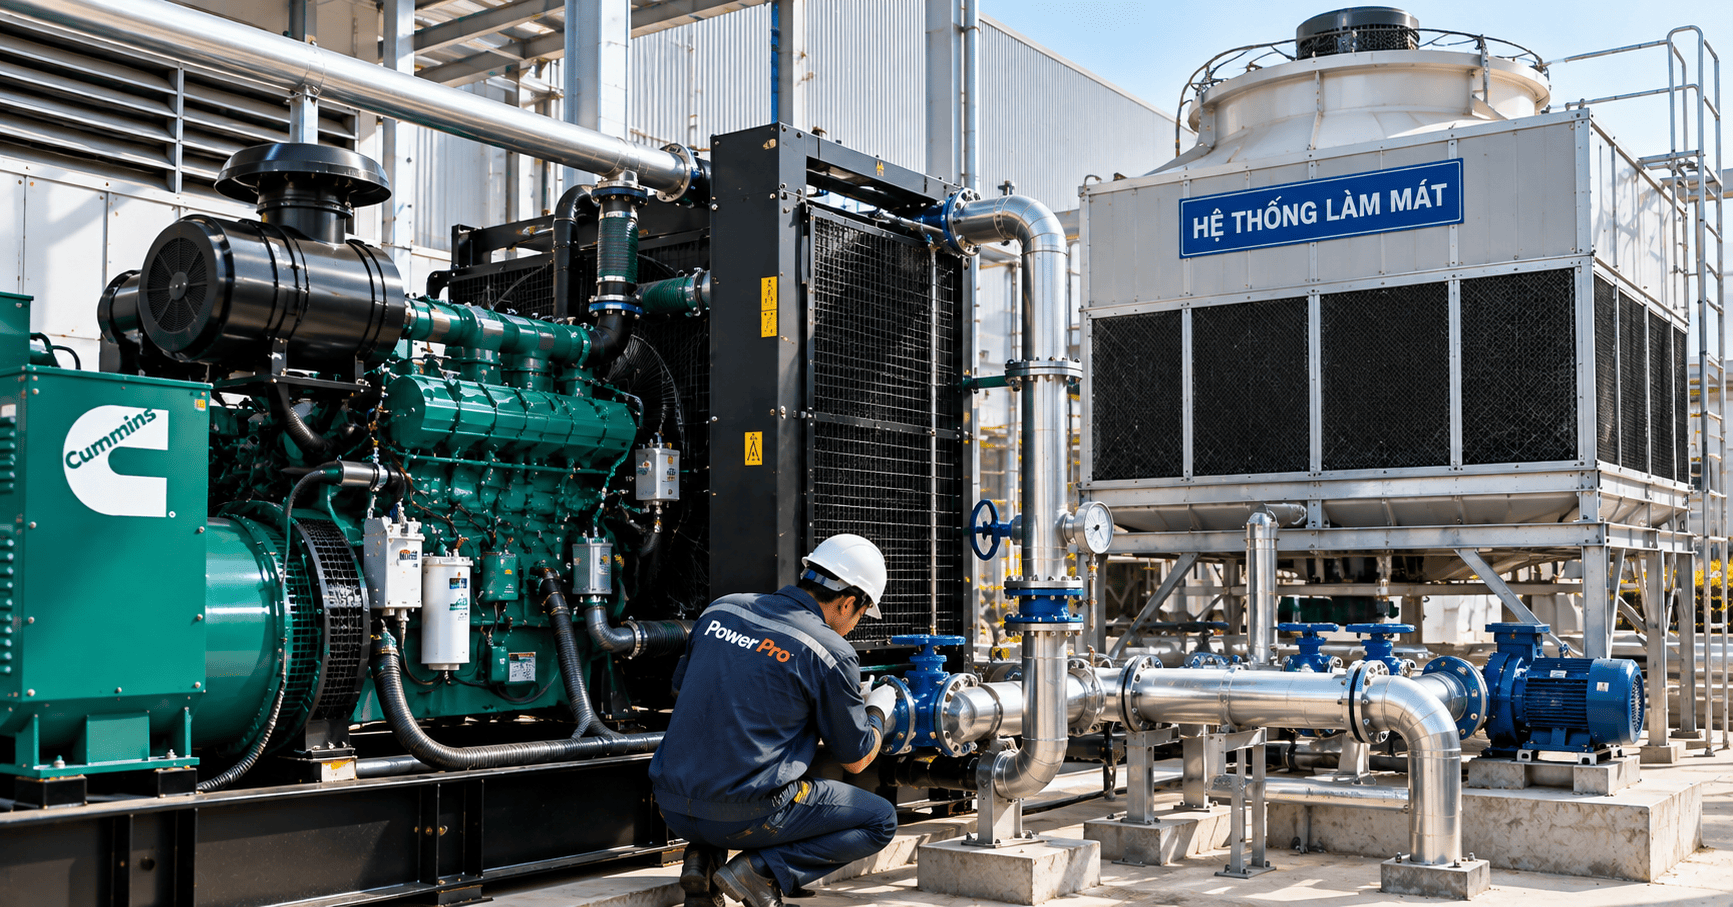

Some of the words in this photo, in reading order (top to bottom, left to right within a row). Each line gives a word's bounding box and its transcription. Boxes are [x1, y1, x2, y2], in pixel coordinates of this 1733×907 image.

[1193, 207, 1224, 242] HỆ
[1231, 195, 1318, 234] THỐNG
[1326, 189, 1381, 222] LÀM
[1390, 178, 1448, 213] MÁT
[65, 408, 157, 469] Cummins
[704, 619, 760, 650] Power
[755, 637, 791, 663] Pro
